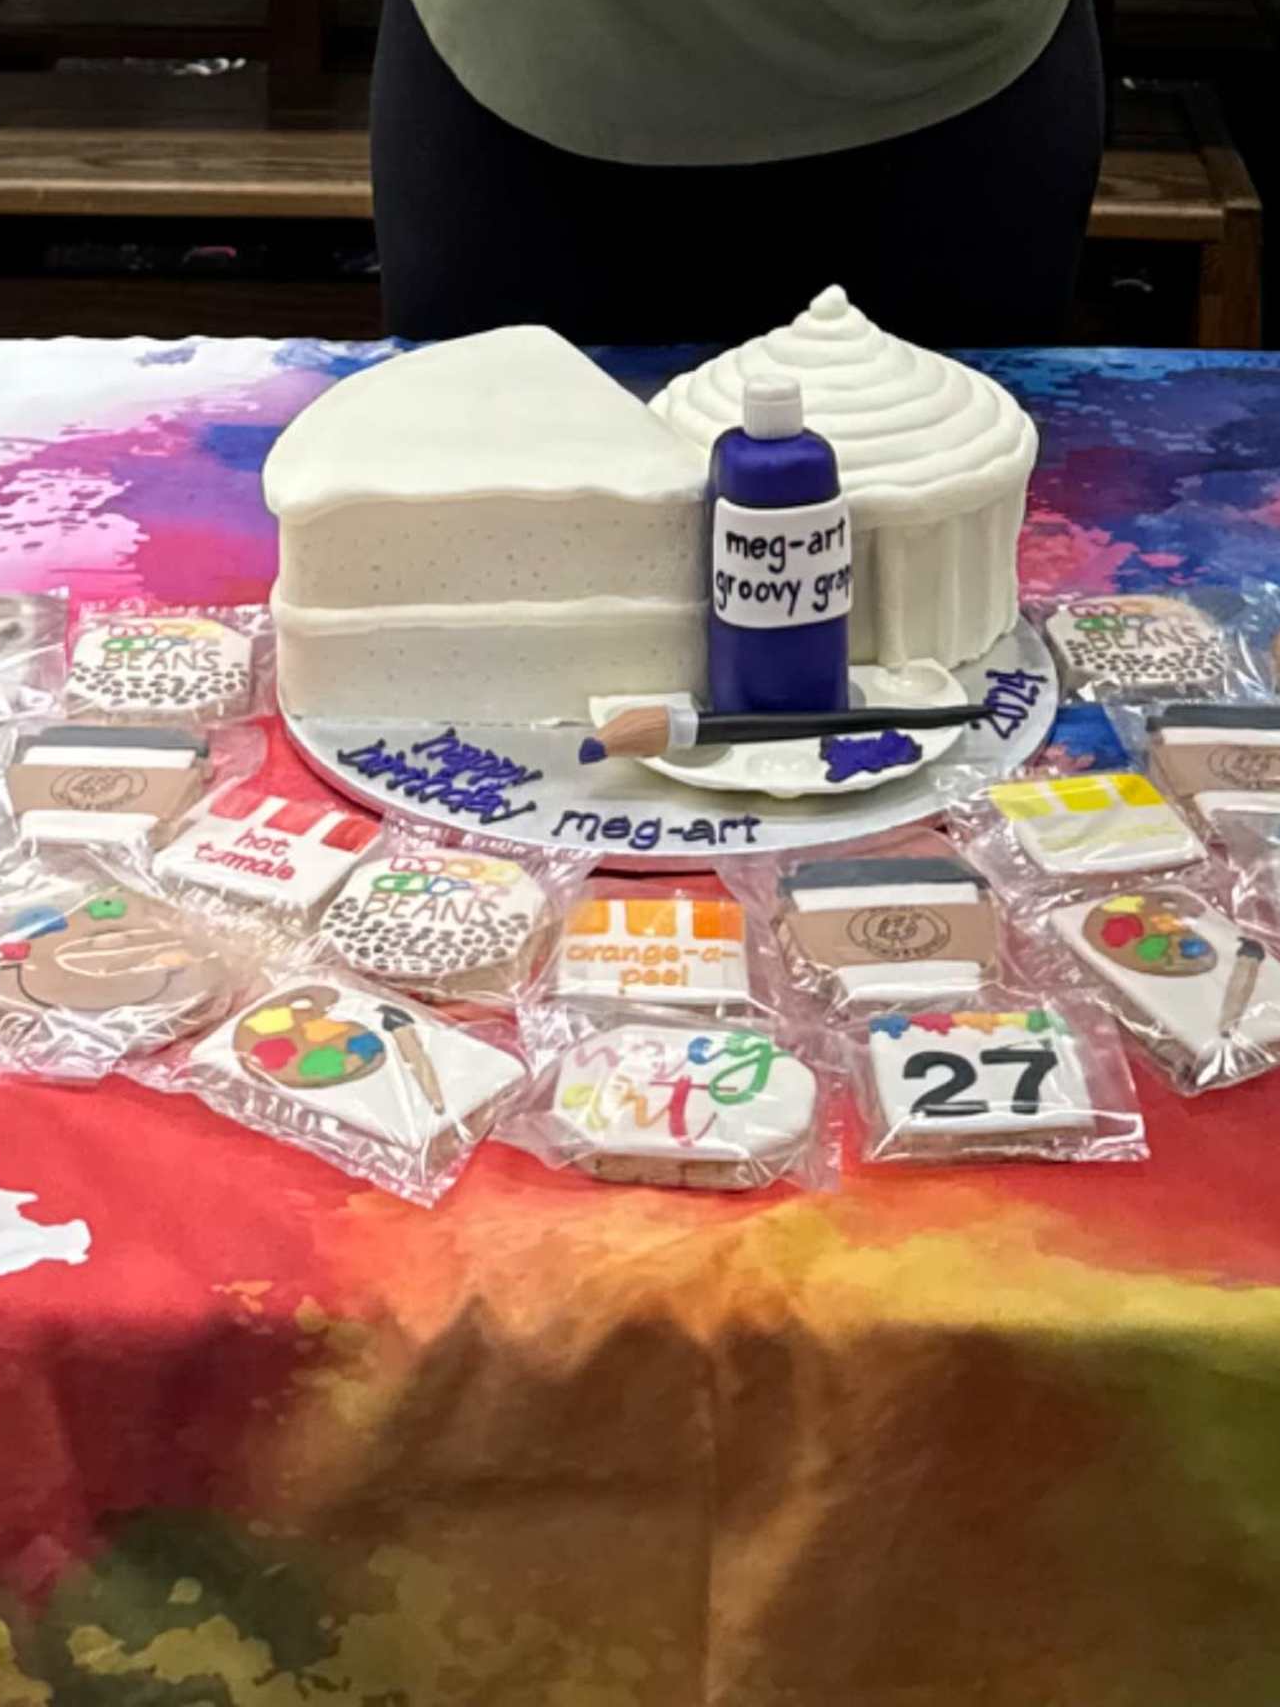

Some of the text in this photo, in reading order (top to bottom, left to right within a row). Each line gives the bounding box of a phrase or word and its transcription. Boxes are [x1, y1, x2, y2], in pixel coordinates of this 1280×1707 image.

[725, 515, 847, 575] meg-art
[715, 569, 802, 618] groovy
[1084, 619, 1212, 653] BEANS
[101, 650, 223, 673] BEANS
[232, 826, 292, 858] hot
[551, 809, 762, 851] meg-art
[362, 890, 501, 927] BEANS
[620, 964, 690, 989] peel
[903, 1046, 1059, 1118] 27
